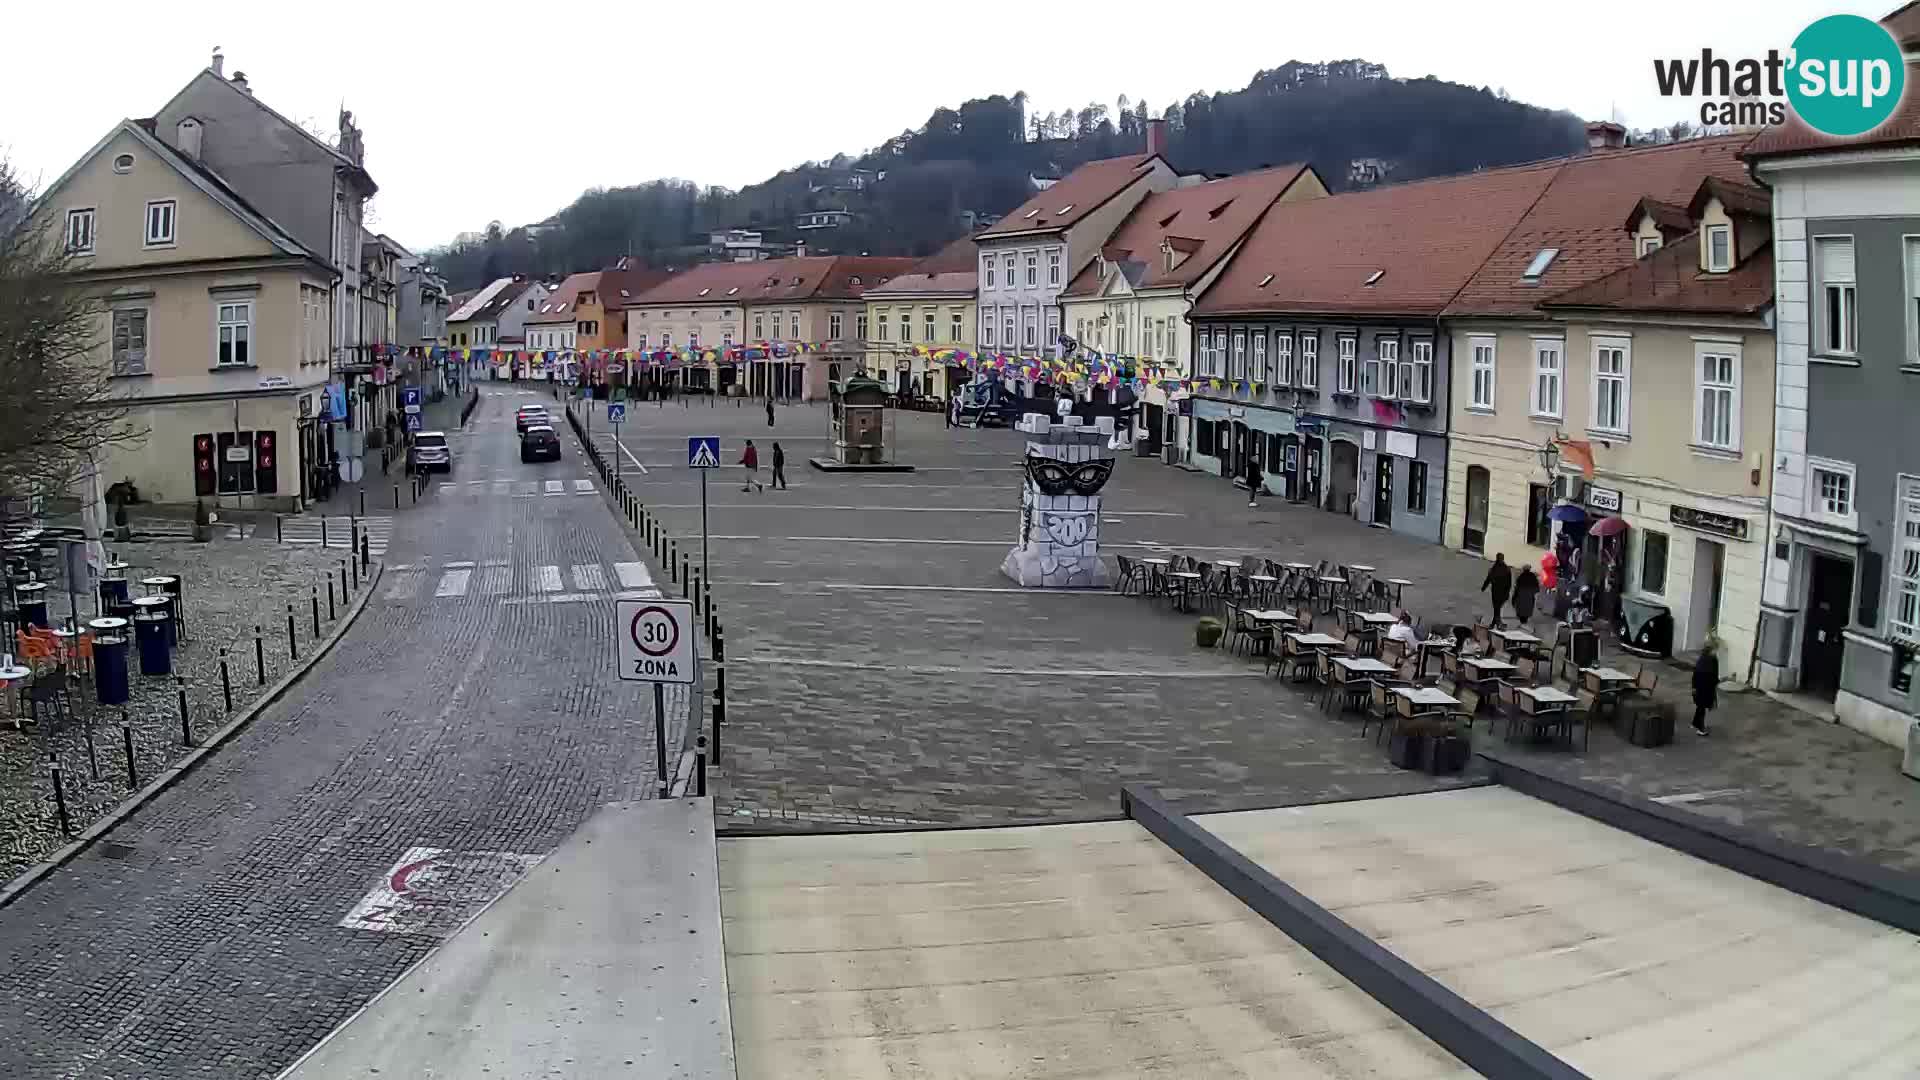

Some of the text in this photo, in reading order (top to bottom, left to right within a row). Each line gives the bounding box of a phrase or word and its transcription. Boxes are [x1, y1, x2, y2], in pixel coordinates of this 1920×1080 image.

[408, 391, 416, 402] P
[643, 622, 667, 642] 30
[634, 660, 678, 676] ZONA
